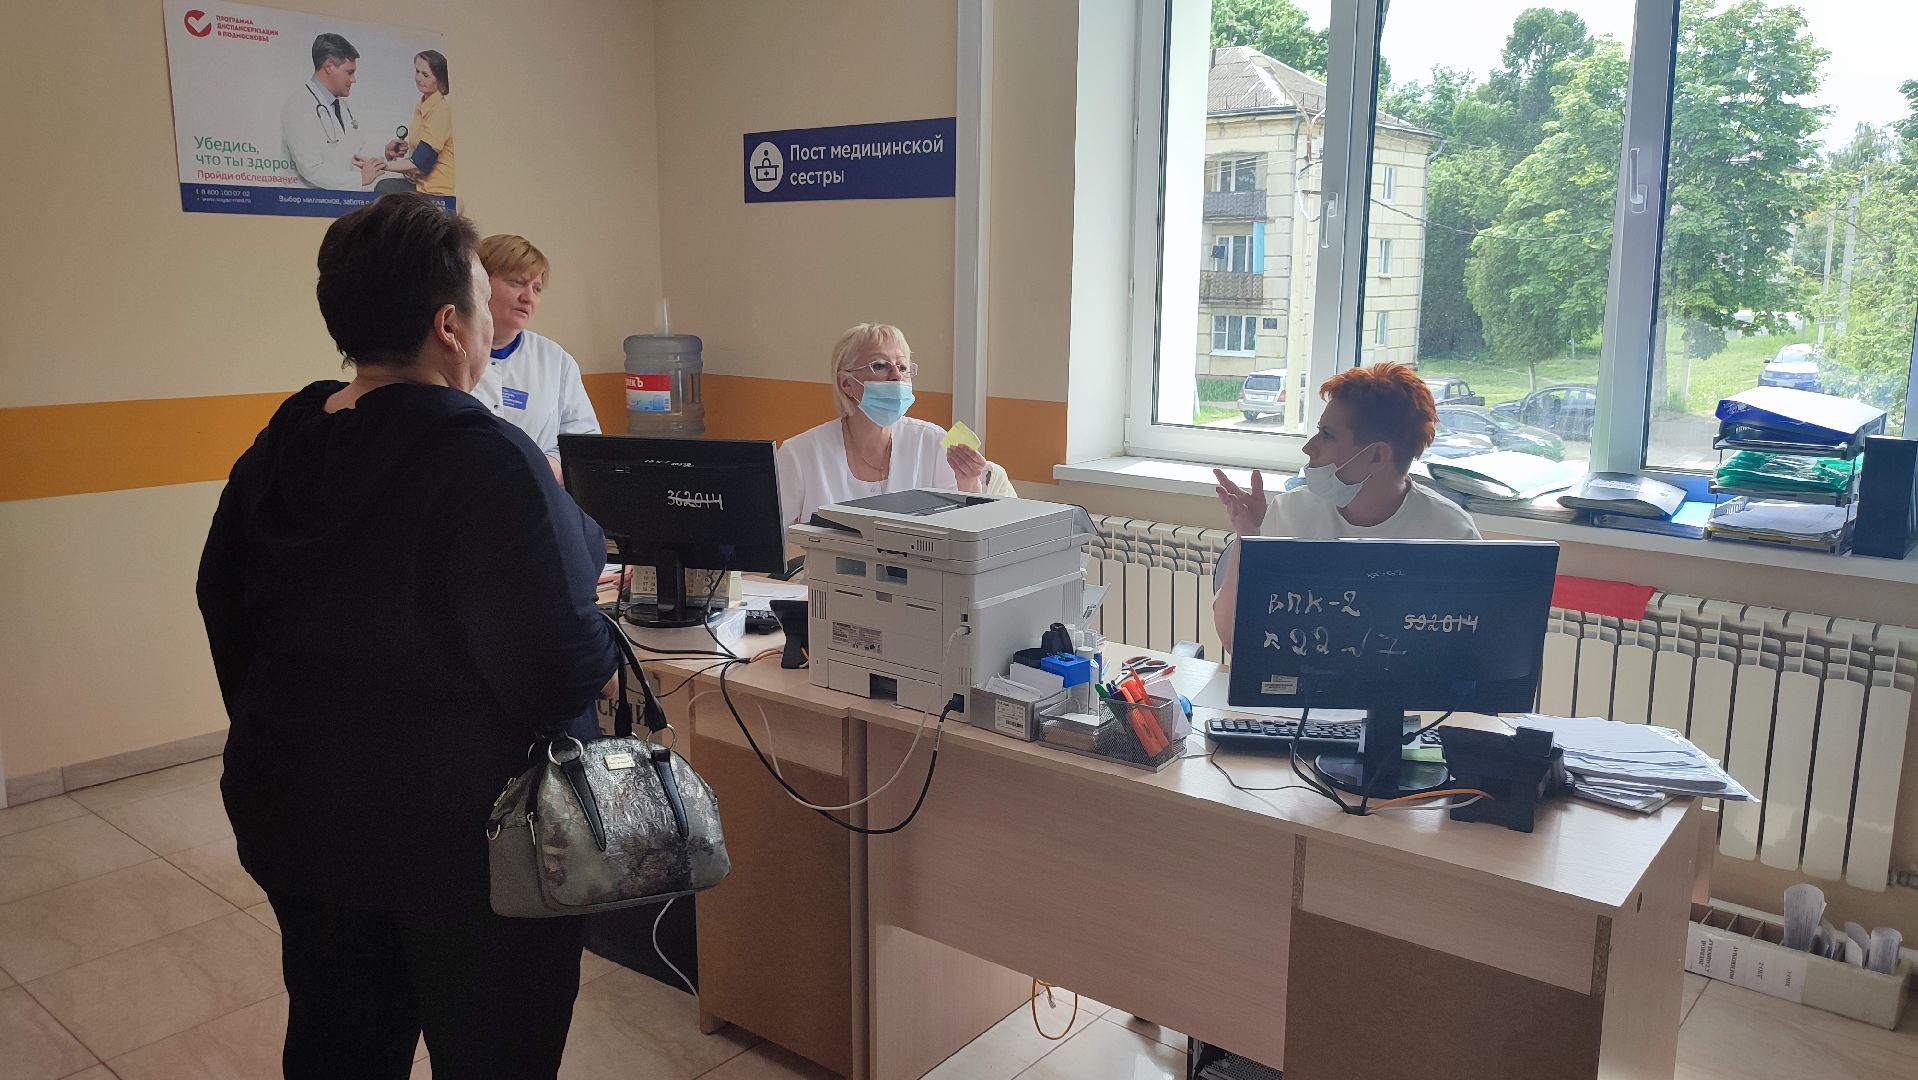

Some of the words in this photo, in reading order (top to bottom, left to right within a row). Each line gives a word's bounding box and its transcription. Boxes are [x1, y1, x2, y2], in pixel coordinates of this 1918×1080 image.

[216, 15, 254, 25] ПРОГРАММА
[217, 23, 279, 36] ДИСПАНСЕРИЗАЦИИ
[223, 31, 270, 42] ПОДМОСКОВЬЕ
[193, 135, 260, 154] Убедись,
[790, 143, 825, 161] Пост
[830, 134, 944, 161] медицинской
[196, 154, 222, 165] что
[223, 156, 244, 167] ты
[247, 157, 297, 172] здоров
[197, 169, 234, 181] Пройди
[790, 169, 845, 187] сестры
[279, 195, 301, 204] Выбор
